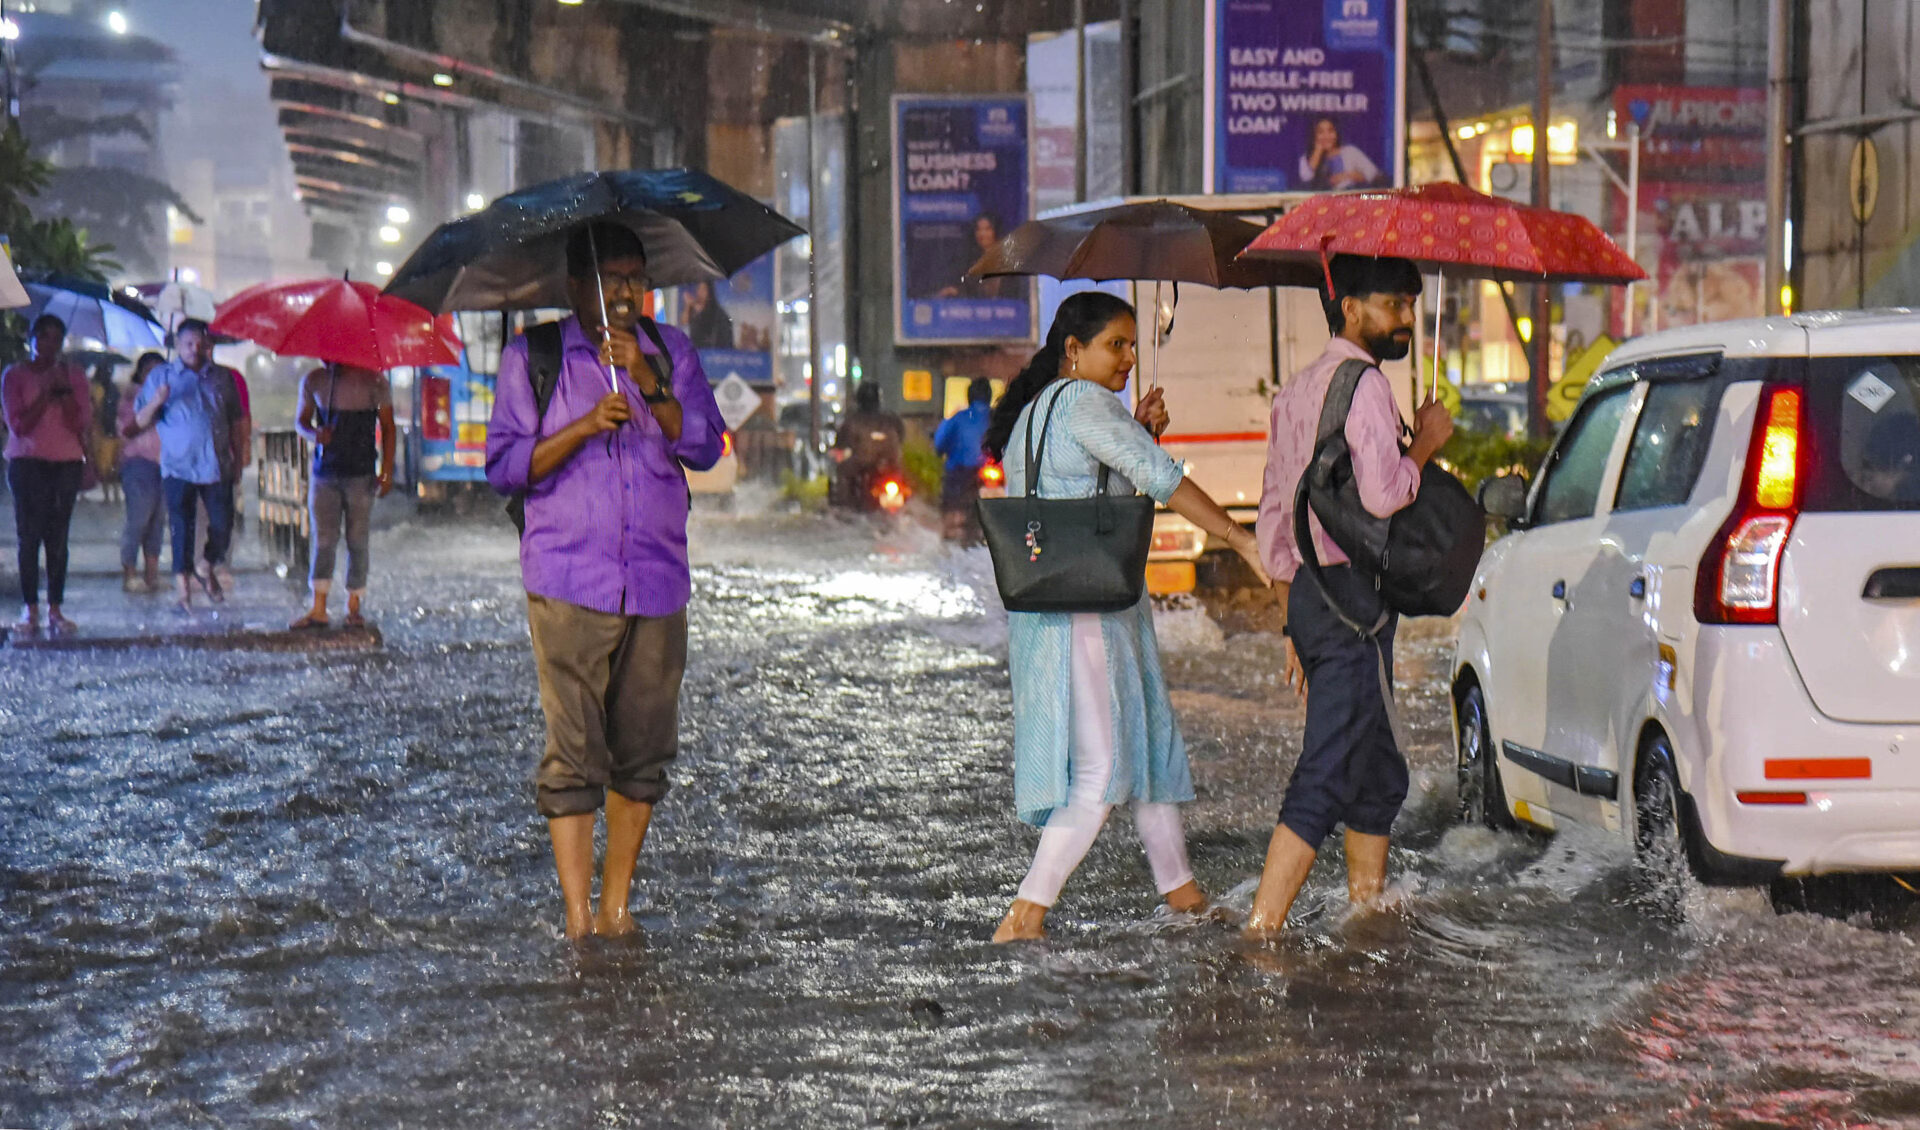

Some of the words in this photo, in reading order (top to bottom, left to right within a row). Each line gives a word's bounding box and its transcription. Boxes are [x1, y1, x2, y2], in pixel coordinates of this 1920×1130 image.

[1229, 48, 1279, 66] EASY
[1282, 49, 1325, 66] AND
[1229, 71, 1354, 89] HASSLE-FREE
[1230, 93, 1277, 111] TWO
[1280, 94, 1369, 112] WHEELER
[907, 153, 998, 171] BUSINESS
[907, 172, 971, 191] LOAN?
